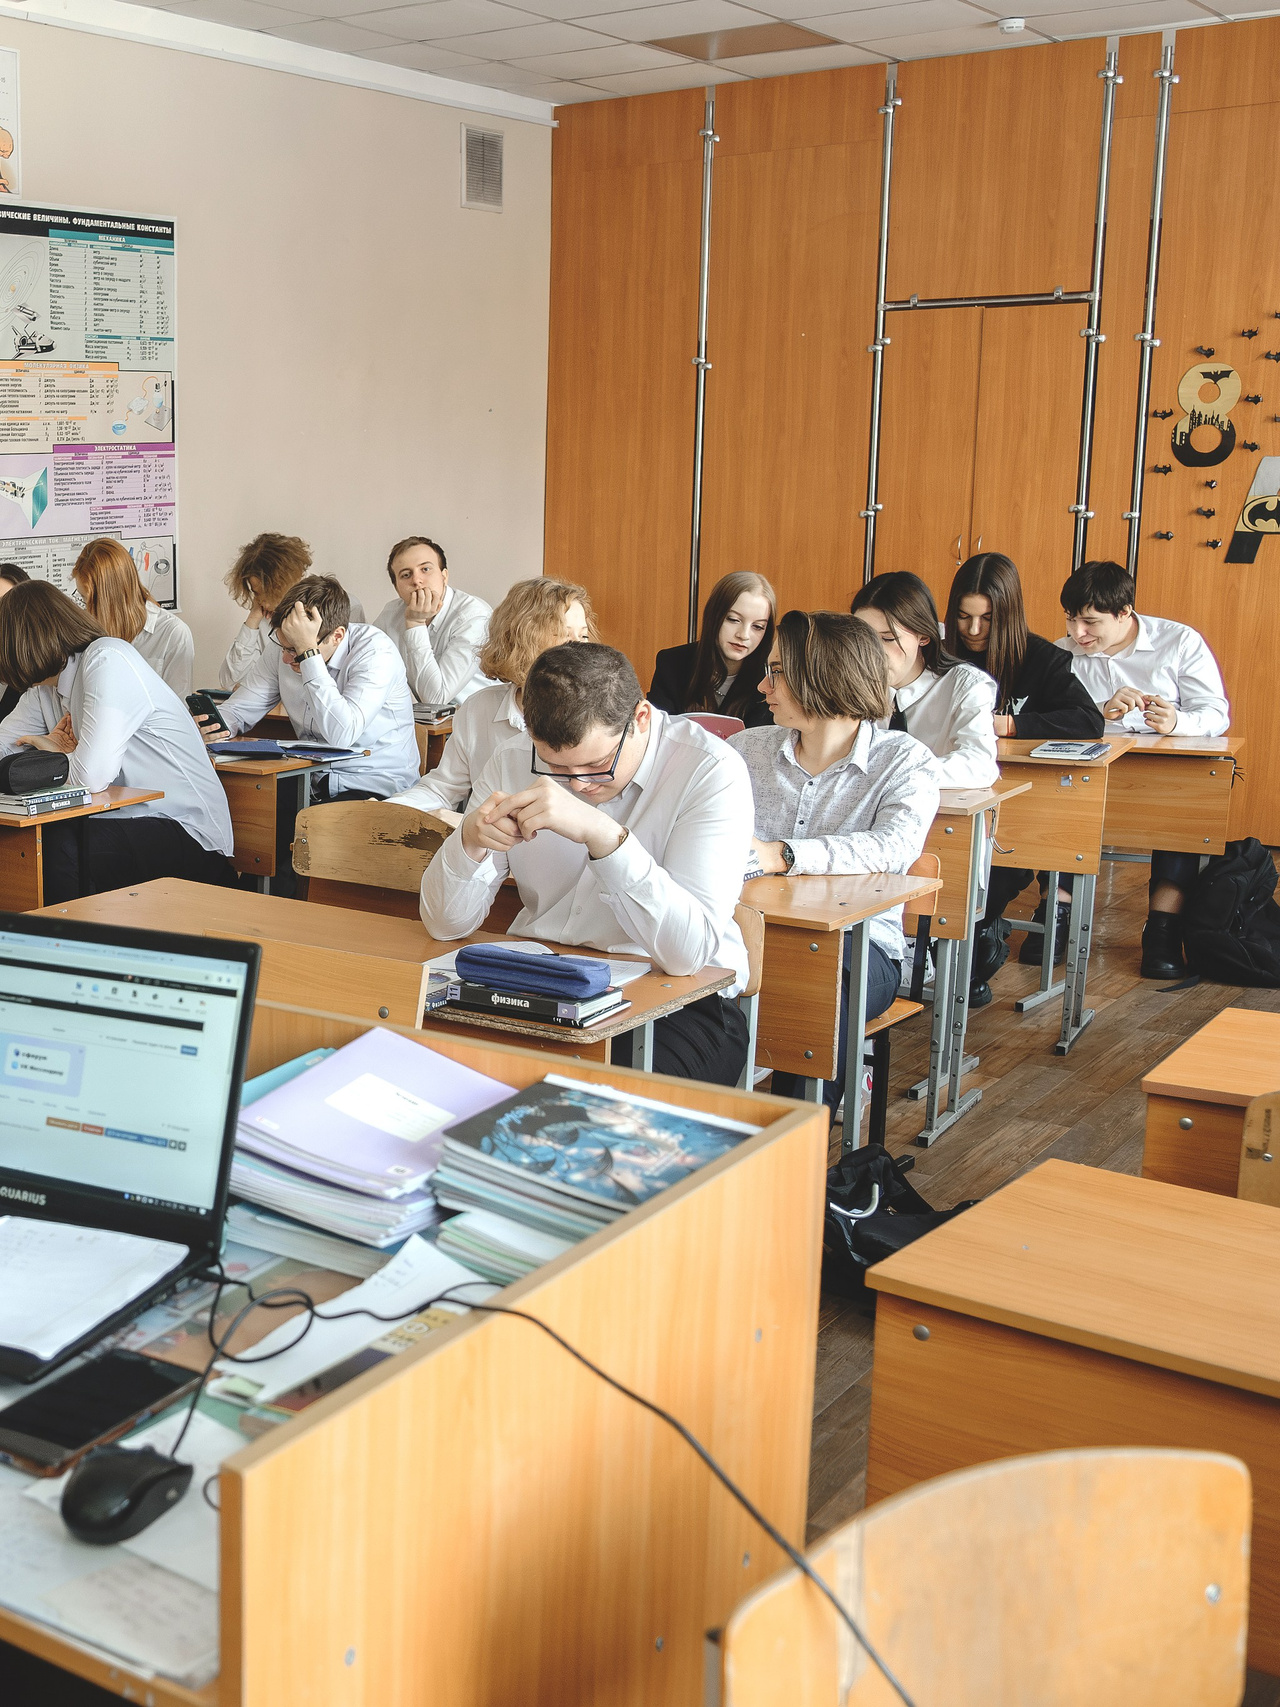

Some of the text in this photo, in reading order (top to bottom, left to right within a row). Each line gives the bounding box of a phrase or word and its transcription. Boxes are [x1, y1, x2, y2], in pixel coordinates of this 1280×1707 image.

[32, 214, 71, 225] ВЕЛИЧИНЫ.
[72, 217, 136, 232] ФУНДАМЕНТАЛЬНЫЕ
[136, 224, 172, 234] КОНСТАНТЫ
[98, 234, 126, 244] МЕХАНИКА
[1171, 362, 1242, 468] 8
[94, 444, 137, 452] ЭЛЕКТРОСТАТИКА
[491, 993, 530, 1008] физика
